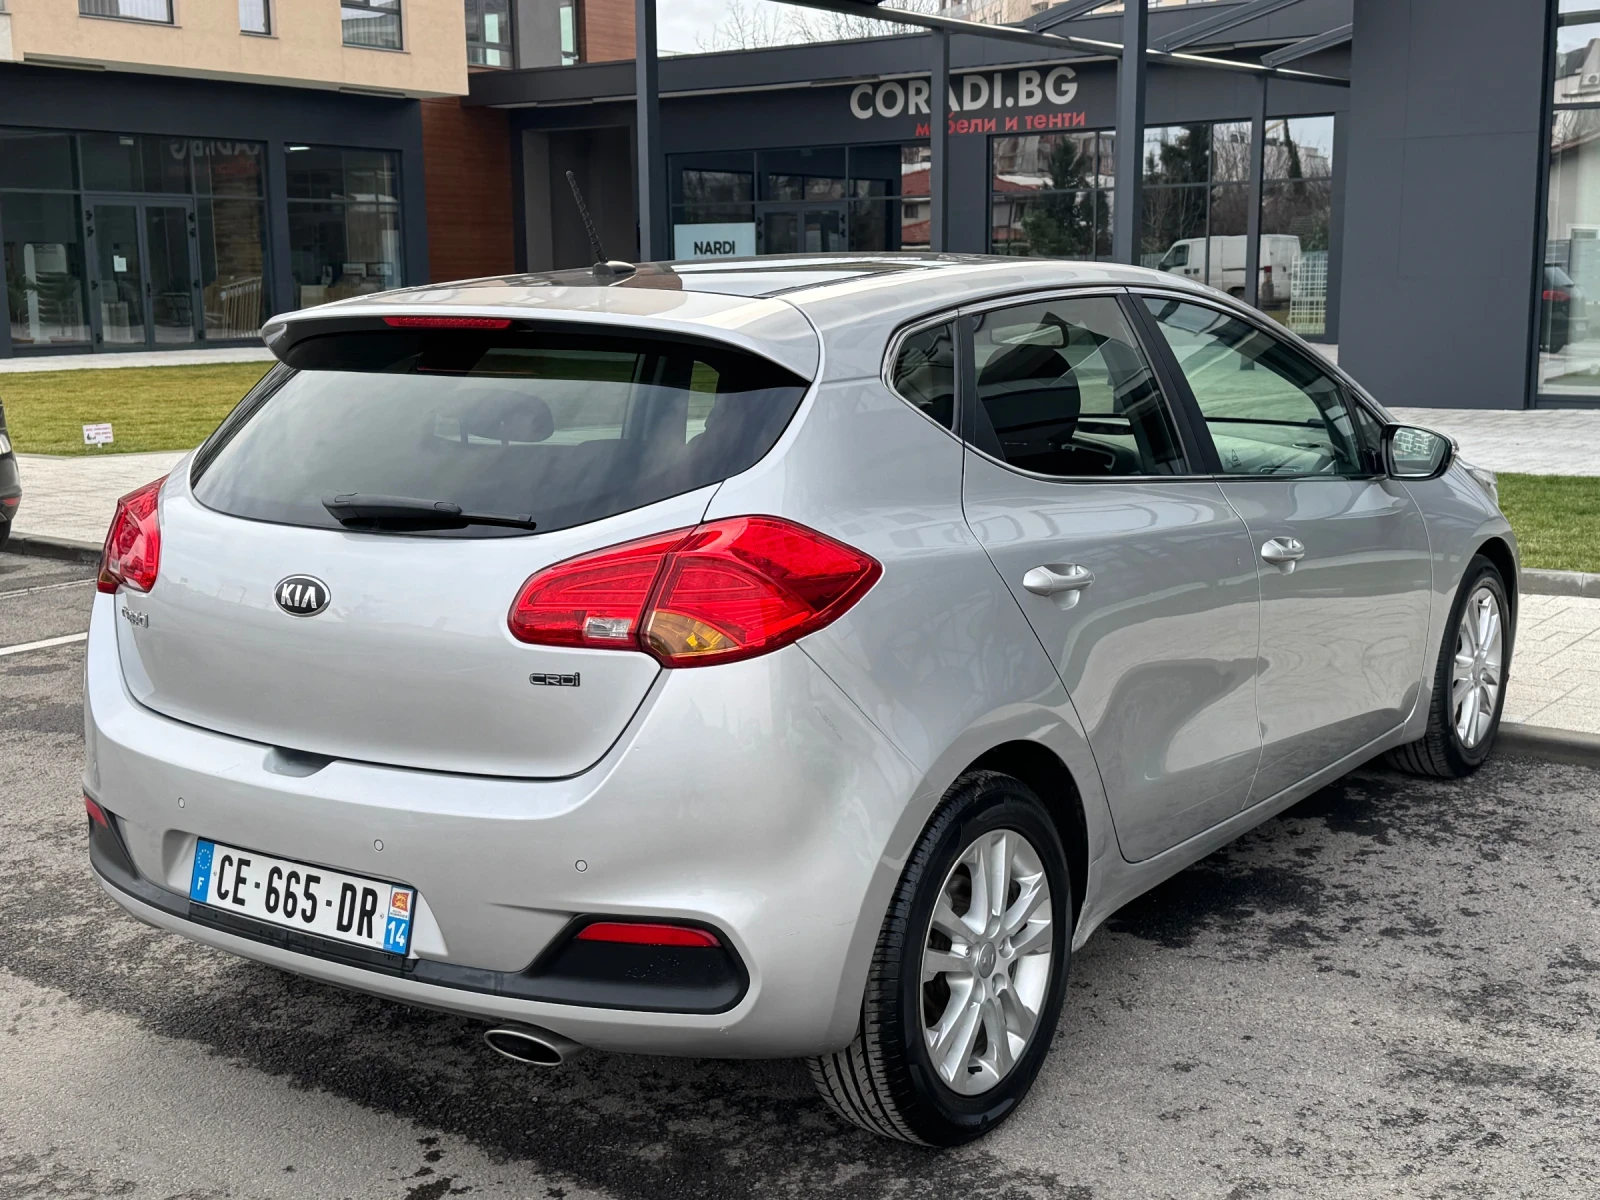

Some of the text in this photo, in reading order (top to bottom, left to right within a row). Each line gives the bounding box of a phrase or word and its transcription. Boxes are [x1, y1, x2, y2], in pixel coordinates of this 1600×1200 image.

[915, 111, 1086, 137] мбели и тенти
[694, 240, 735, 255] NARDI
[281, 583, 317, 608] KIA
[196, 877, 205, 891] F
[388, 920, 406, 947] 14
